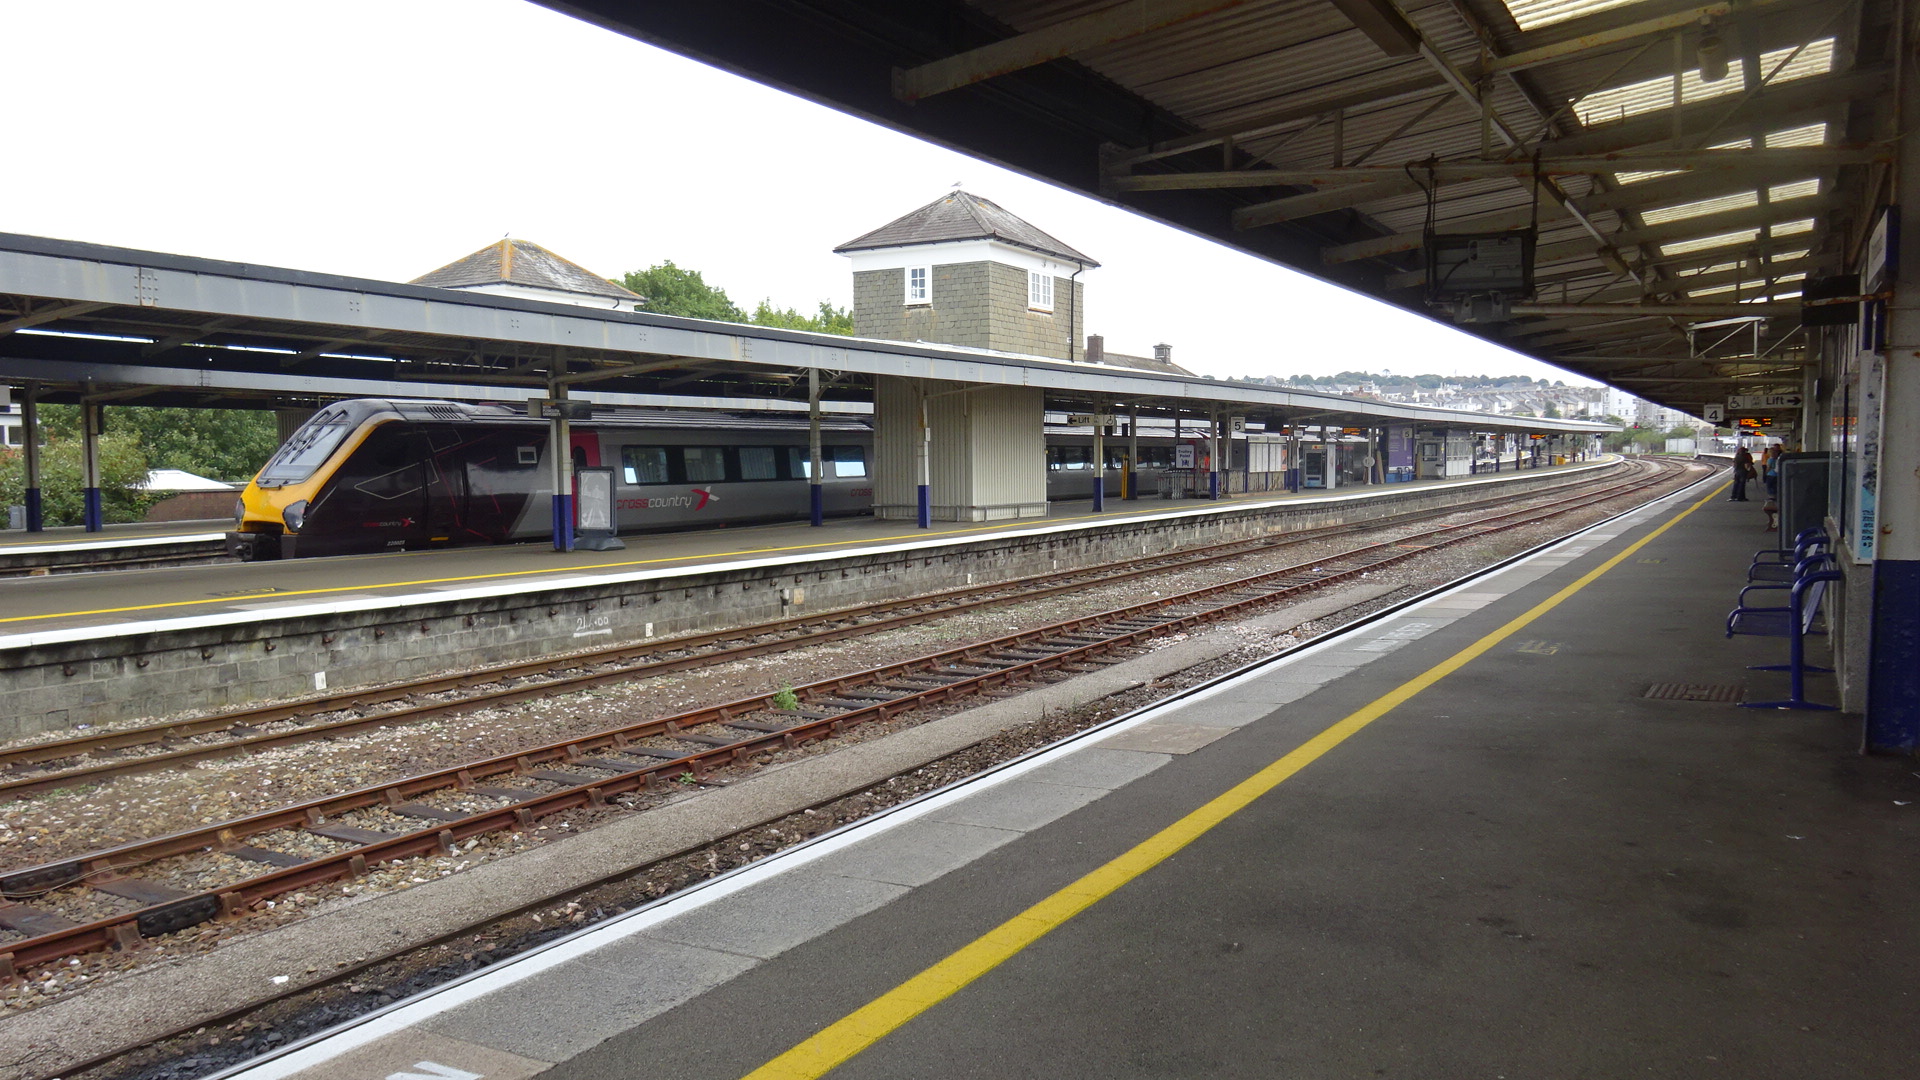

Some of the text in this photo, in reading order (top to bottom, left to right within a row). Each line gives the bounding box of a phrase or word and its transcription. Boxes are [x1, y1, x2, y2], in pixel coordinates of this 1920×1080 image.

[1766, 396, 1784, 406] Lift
[1078, 416, 1090, 424] Lift
[1708, 410, 1719, 421] 4
[1234, 421, 1241, 431] 5
[616, 495, 692, 510] crosscountry
